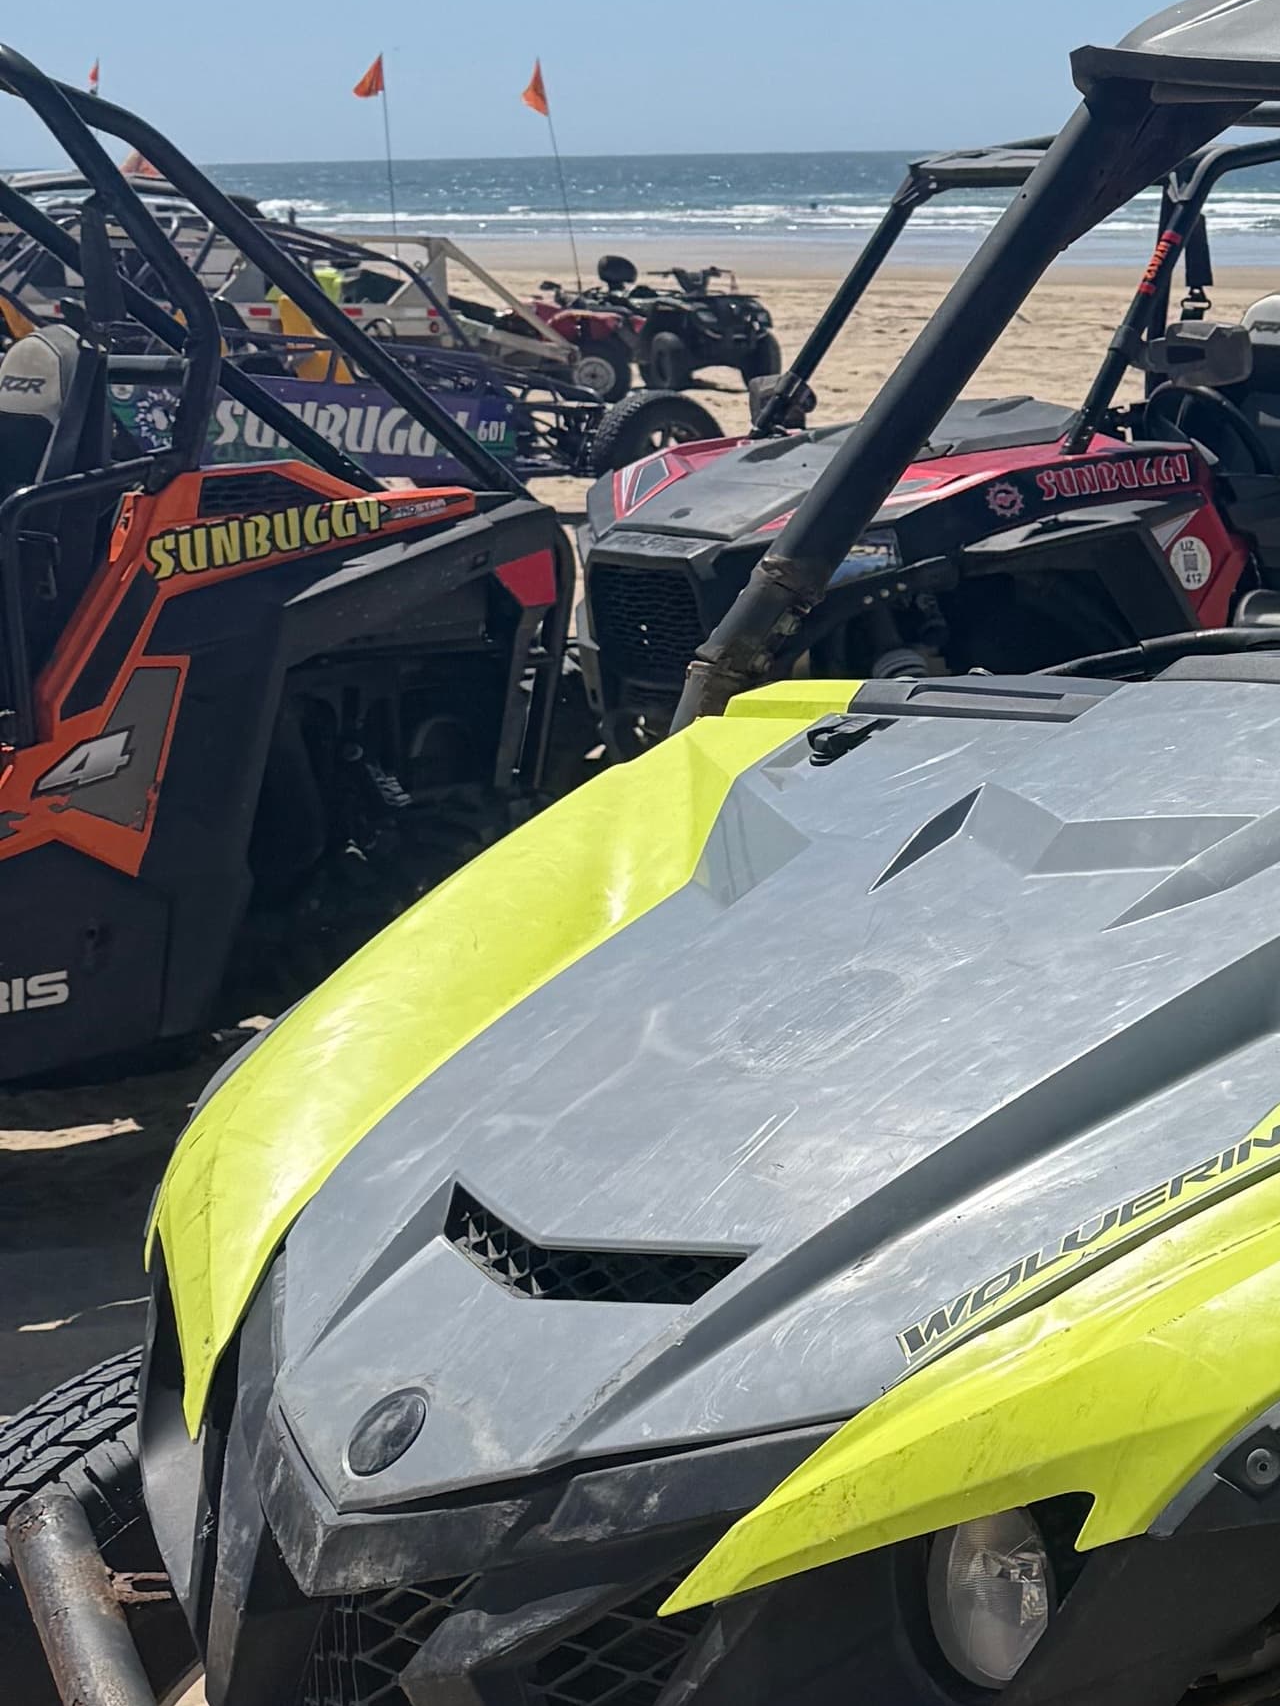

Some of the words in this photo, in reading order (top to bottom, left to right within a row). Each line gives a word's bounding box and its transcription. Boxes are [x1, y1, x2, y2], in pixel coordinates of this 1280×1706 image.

[0, 374, 47, 395] RZR
[476, 420, 507, 443] 601
[1035, 453, 1192, 501] SUNBUGGY
[146, 496, 383, 581] SUNBUGGY
